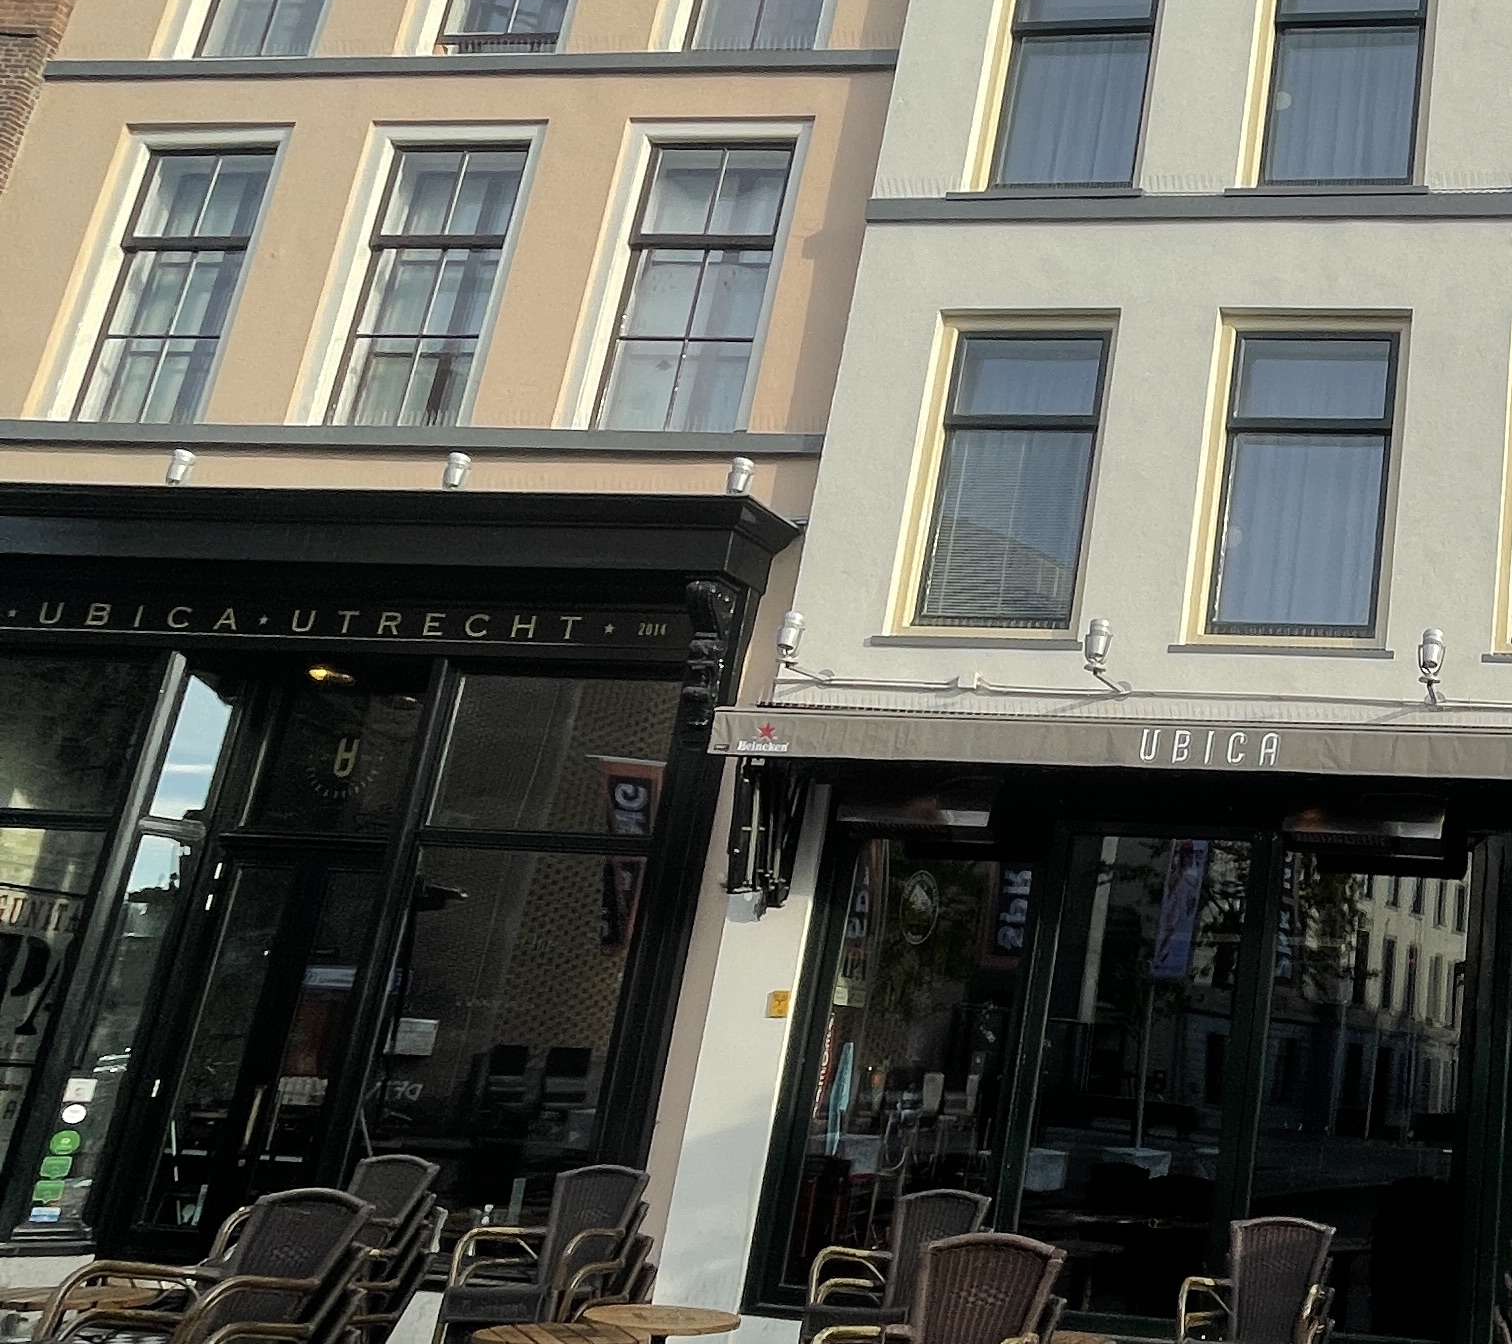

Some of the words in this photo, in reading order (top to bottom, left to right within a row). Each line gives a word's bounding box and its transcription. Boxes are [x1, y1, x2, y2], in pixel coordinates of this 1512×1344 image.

[39, 601, 237, 631] UBICA
[291, 609, 582, 640] UTRECHT
[737, 740, 789, 752] Heineken
[1139, 728, 1281, 767] UBICA
